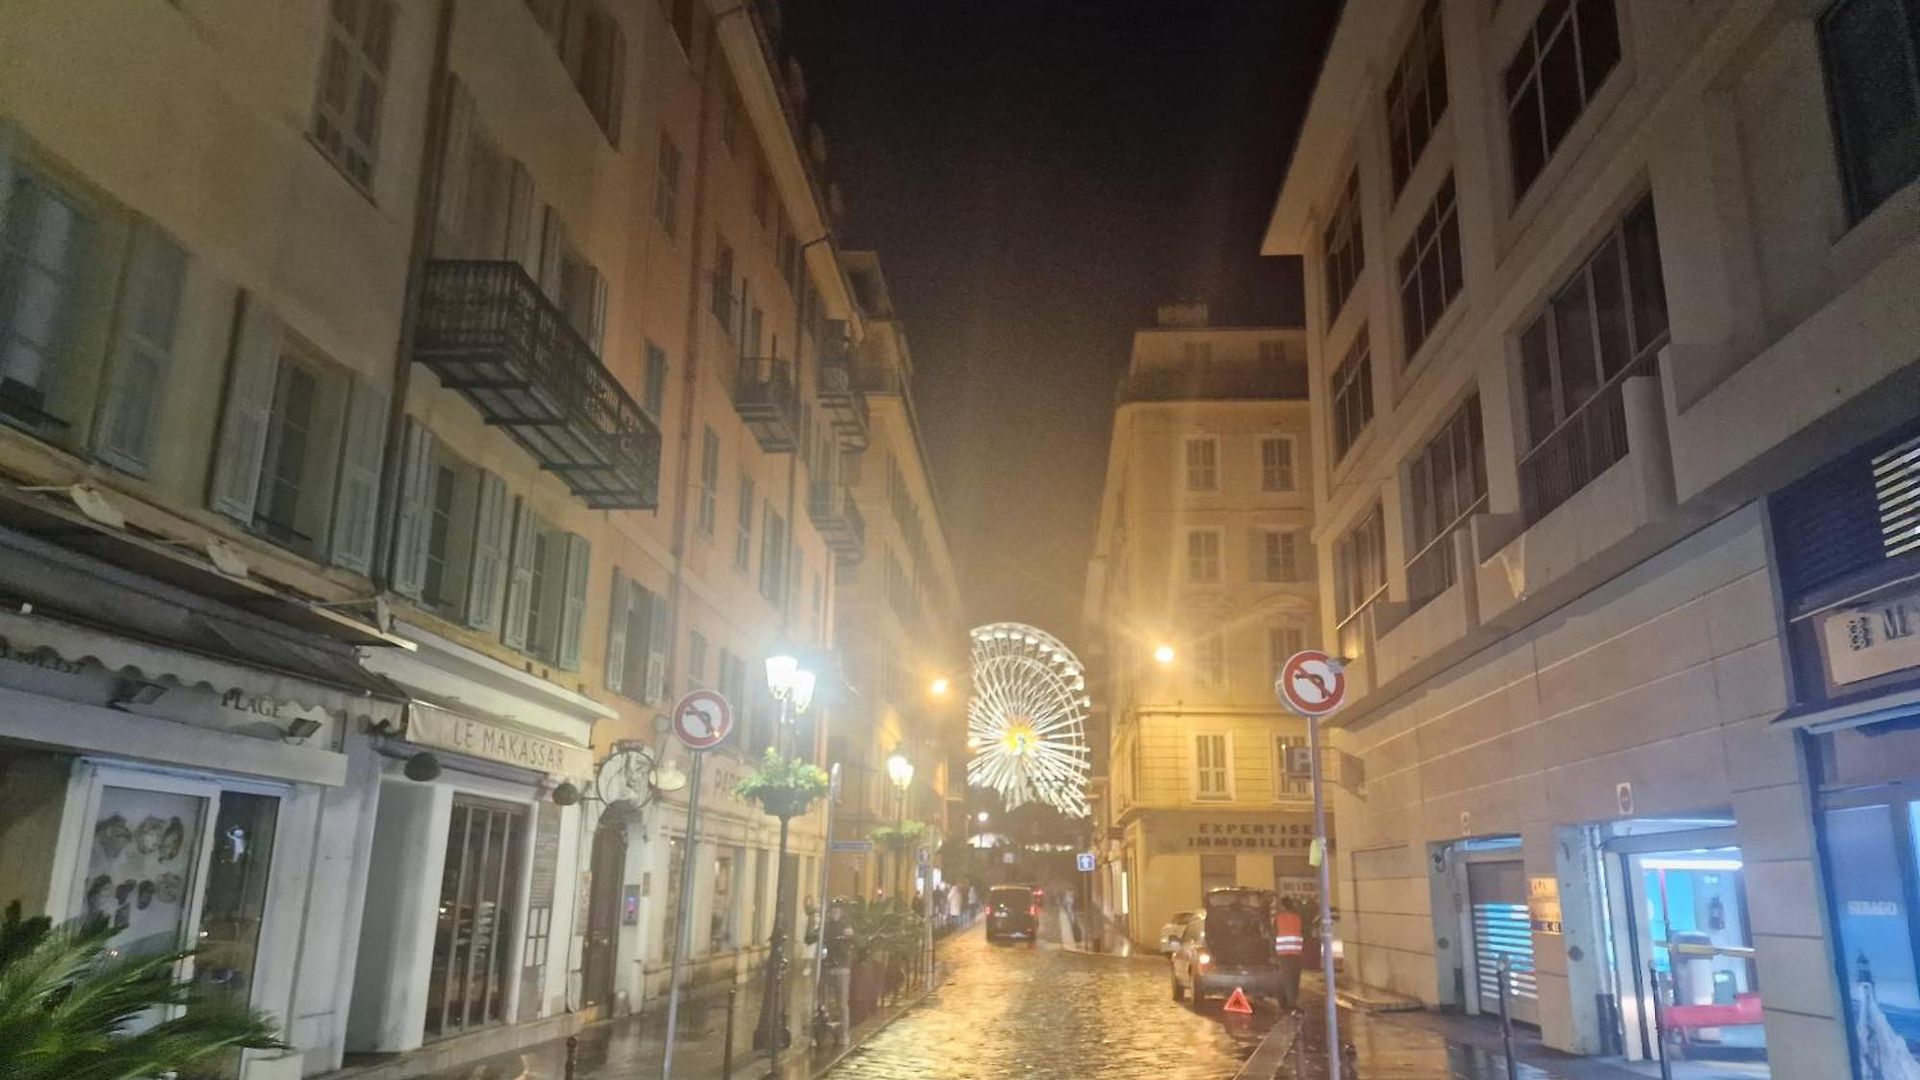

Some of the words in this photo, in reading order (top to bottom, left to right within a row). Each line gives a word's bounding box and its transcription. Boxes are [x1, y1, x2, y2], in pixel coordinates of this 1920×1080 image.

[222, 688, 281, 719] PLAGE
[454, 720, 473, 748] LE
[482, 727, 564, 771] MAKASSAR
